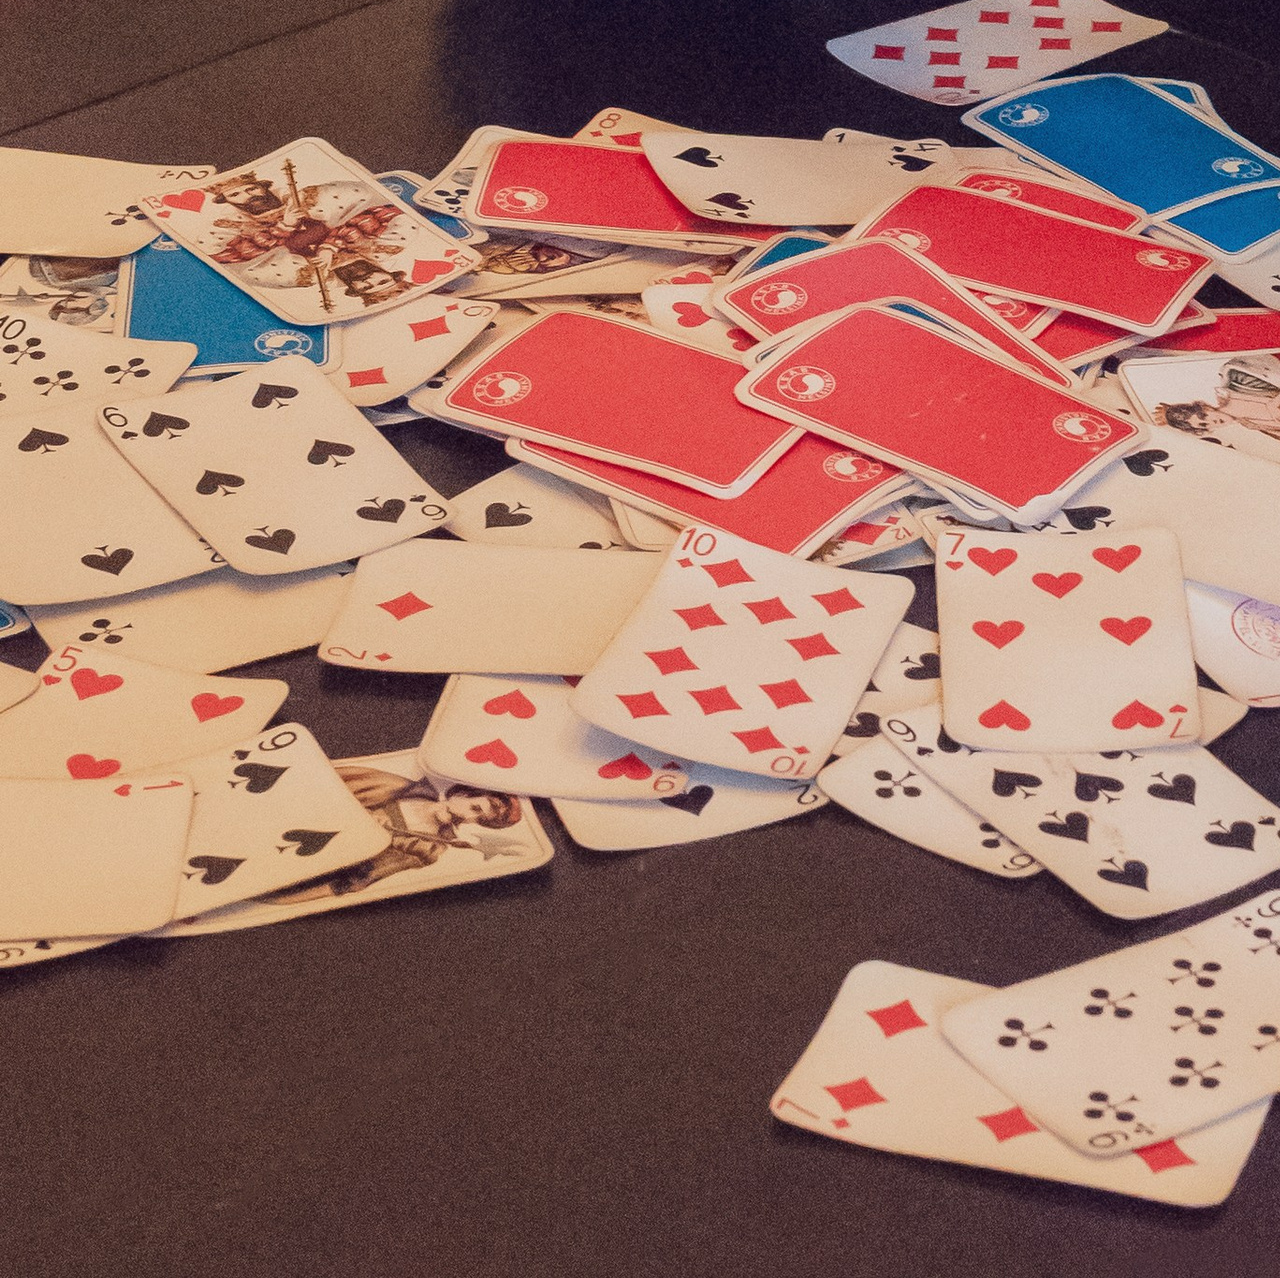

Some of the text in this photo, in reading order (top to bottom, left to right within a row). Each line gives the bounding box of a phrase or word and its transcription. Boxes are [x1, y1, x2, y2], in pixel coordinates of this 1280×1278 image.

[599, 113, 622, 129] 8
[175, 170, 209, 180] 2
[142, 196, 164, 210] 13
[453, 255, 474, 268] 13
[102, 406, 128, 428] 6
[681, 528, 717, 556] 10
[946, 532, 965, 556] 7
[53, 646, 83, 672] 5
[327, 647, 367, 660] 2
[770, 755, 807, 776] 10
